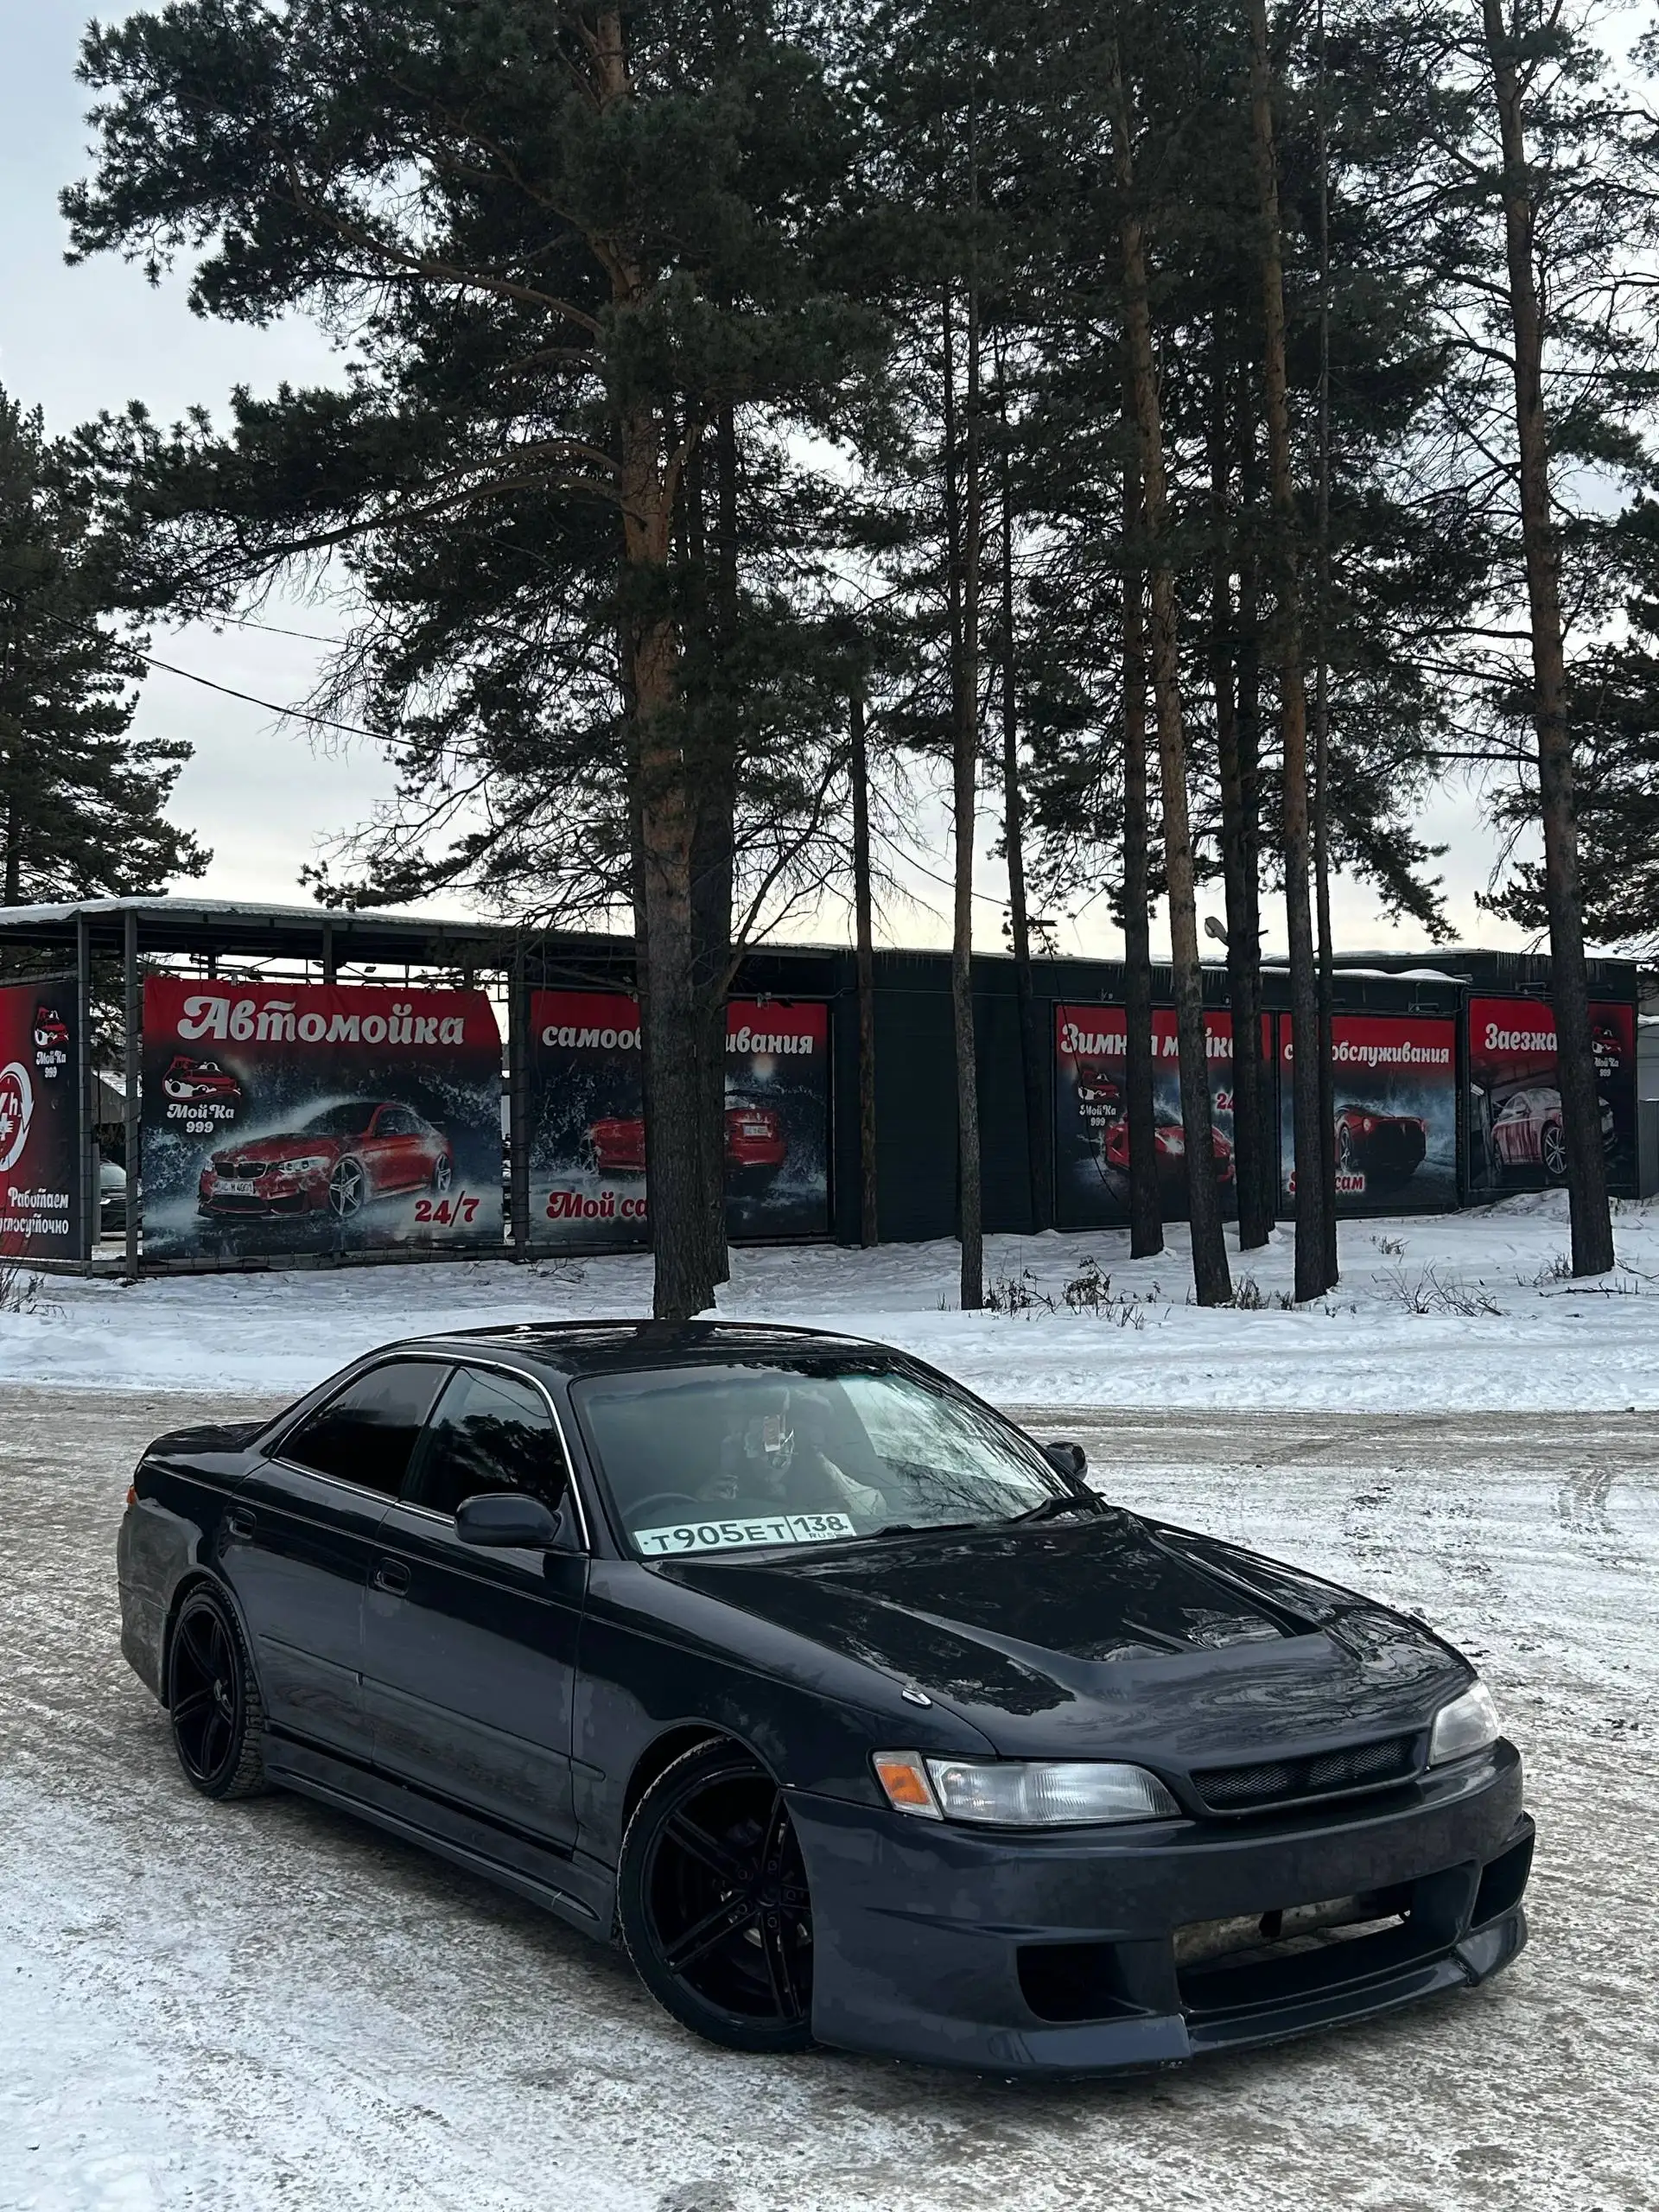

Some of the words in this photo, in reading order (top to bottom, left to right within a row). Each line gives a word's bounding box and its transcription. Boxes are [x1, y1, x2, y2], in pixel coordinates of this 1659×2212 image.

[177, 995, 464, 1045] Автомойка
[1060, 1023, 1158, 1056] Зимн
[1485, 1023, 1558, 1051] Заезжа
[186, 1121, 214, 1134] 999
[1090, 1116, 1106, 1127] 999
[8, 1186, 69, 1209] Работаем
[415, 1190, 480, 1227] 24/7
[546, 1192, 615, 1218] Мой
[620, 1198, 648, 1217] са
[652, 1523, 785, 1551] Т905ЕТ
[794, 1516, 845, 1533] 138
